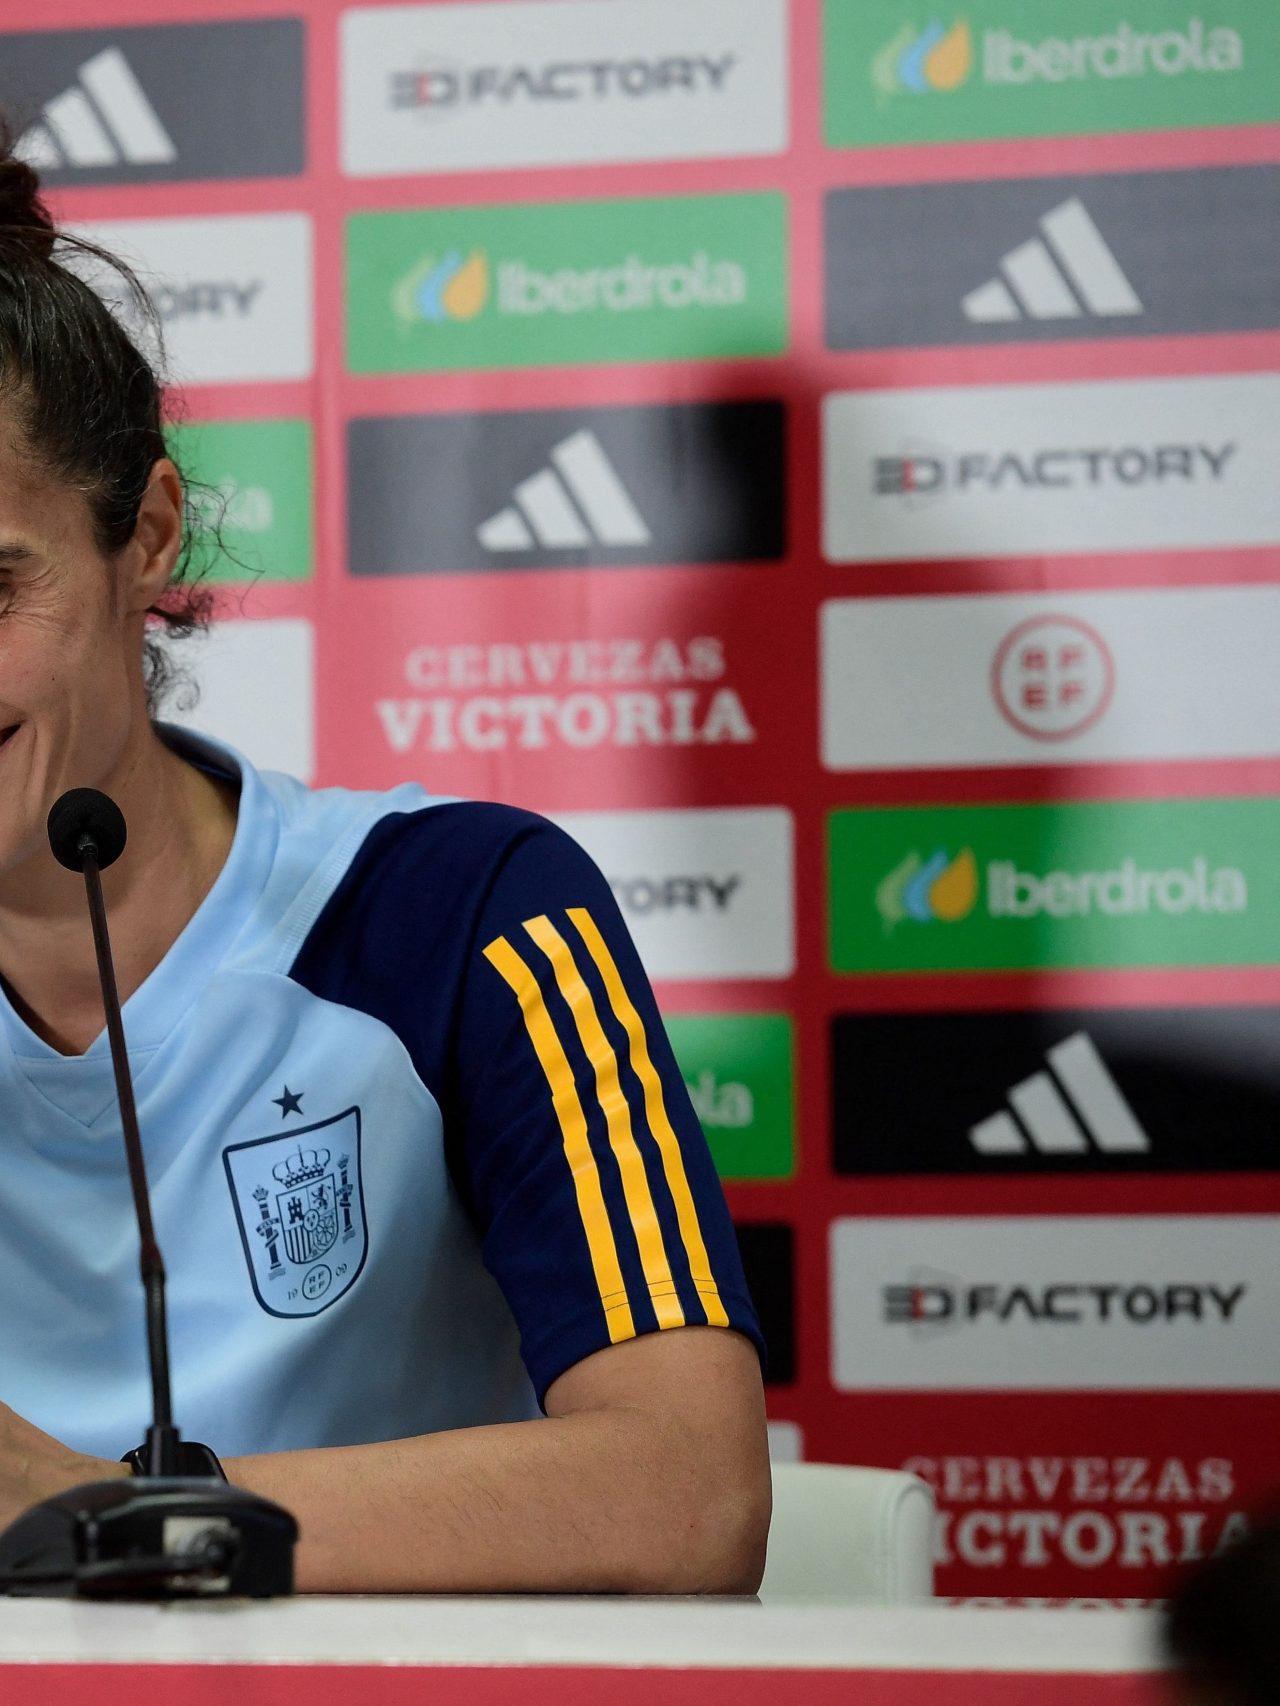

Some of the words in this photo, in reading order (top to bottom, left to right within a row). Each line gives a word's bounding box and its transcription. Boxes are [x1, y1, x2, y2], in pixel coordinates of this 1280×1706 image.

[466, 54, 734, 102] FACTORY
[982, 15, 1243, 84] Iberdrola
[497, 252, 747, 316] Iberdrola
[957, 443, 1235, 490] FACTORY
[406, 637, 725, 688] CERVEZAS
[376, 689, 755, 752] VICTORIA
[987, 856, 1247, 917] Iberdrola
[966, 1284, 1246, 1323] FACTORY
[932, 1510, 1246, 1567] ICTORIA
